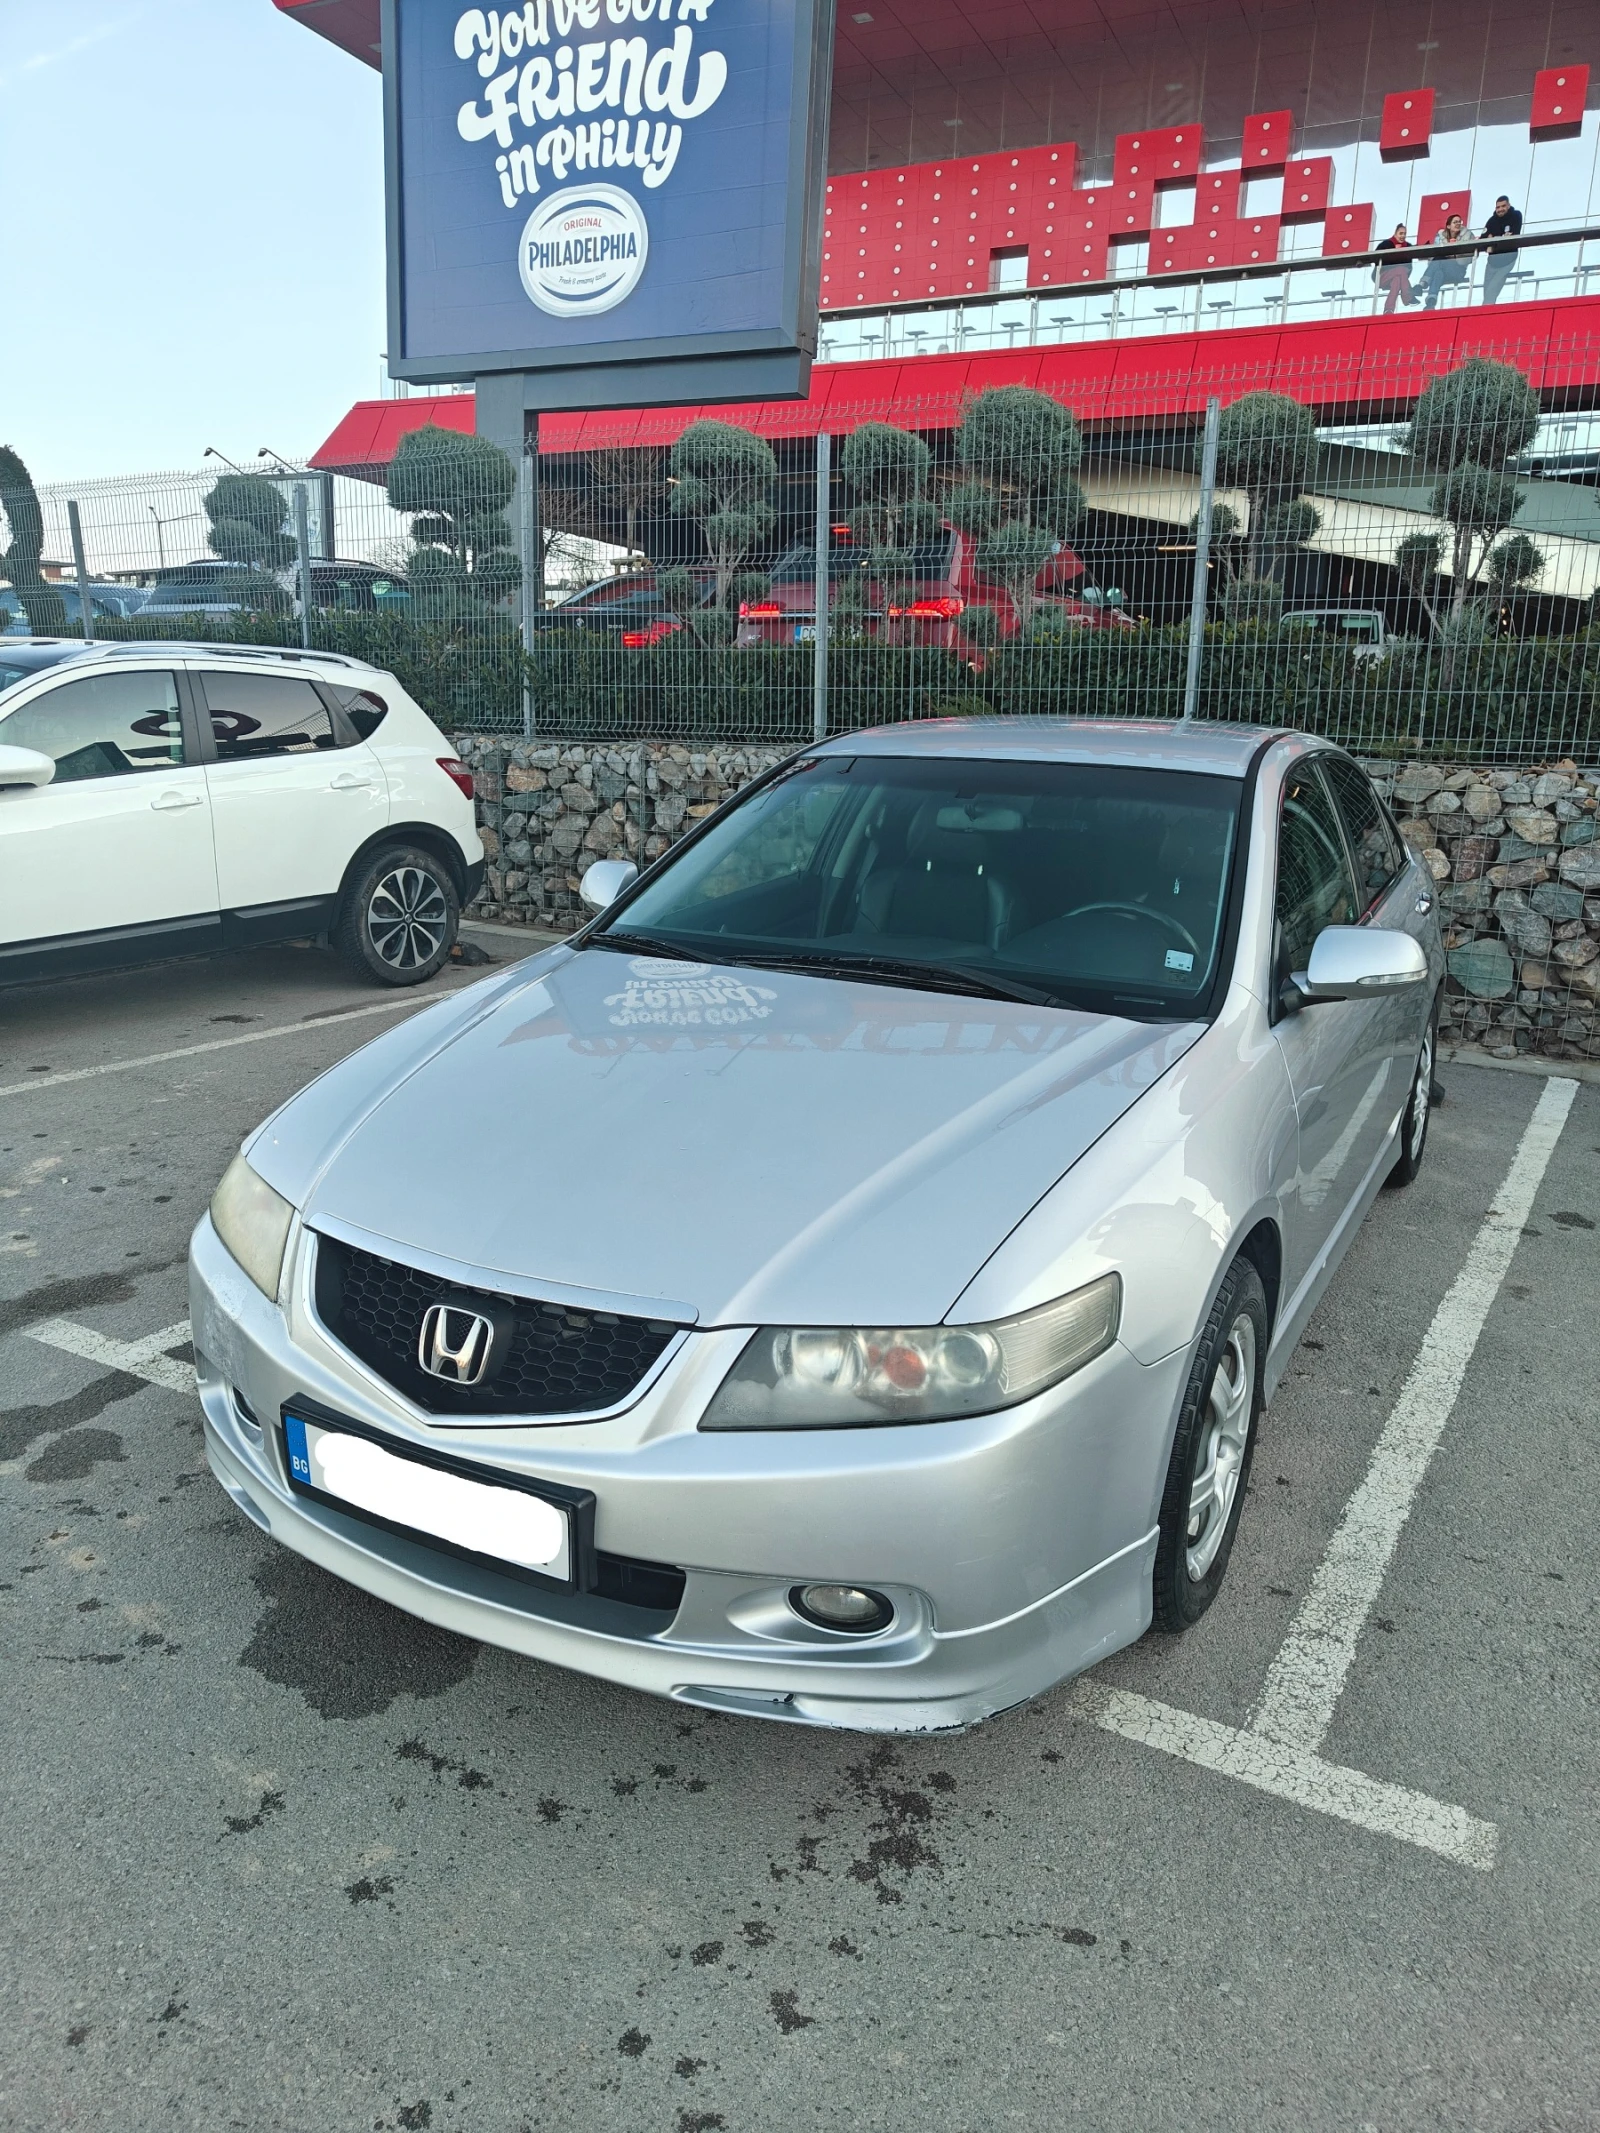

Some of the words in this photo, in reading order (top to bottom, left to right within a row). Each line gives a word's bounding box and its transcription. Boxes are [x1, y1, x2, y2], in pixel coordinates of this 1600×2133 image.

[495, 144, 540, 208] in
[564, 217, 602, 231] ORIGINAL
[528, 232, 637, 271] PHILADELPHIA
[292, 1455, 309, 1474] BG
